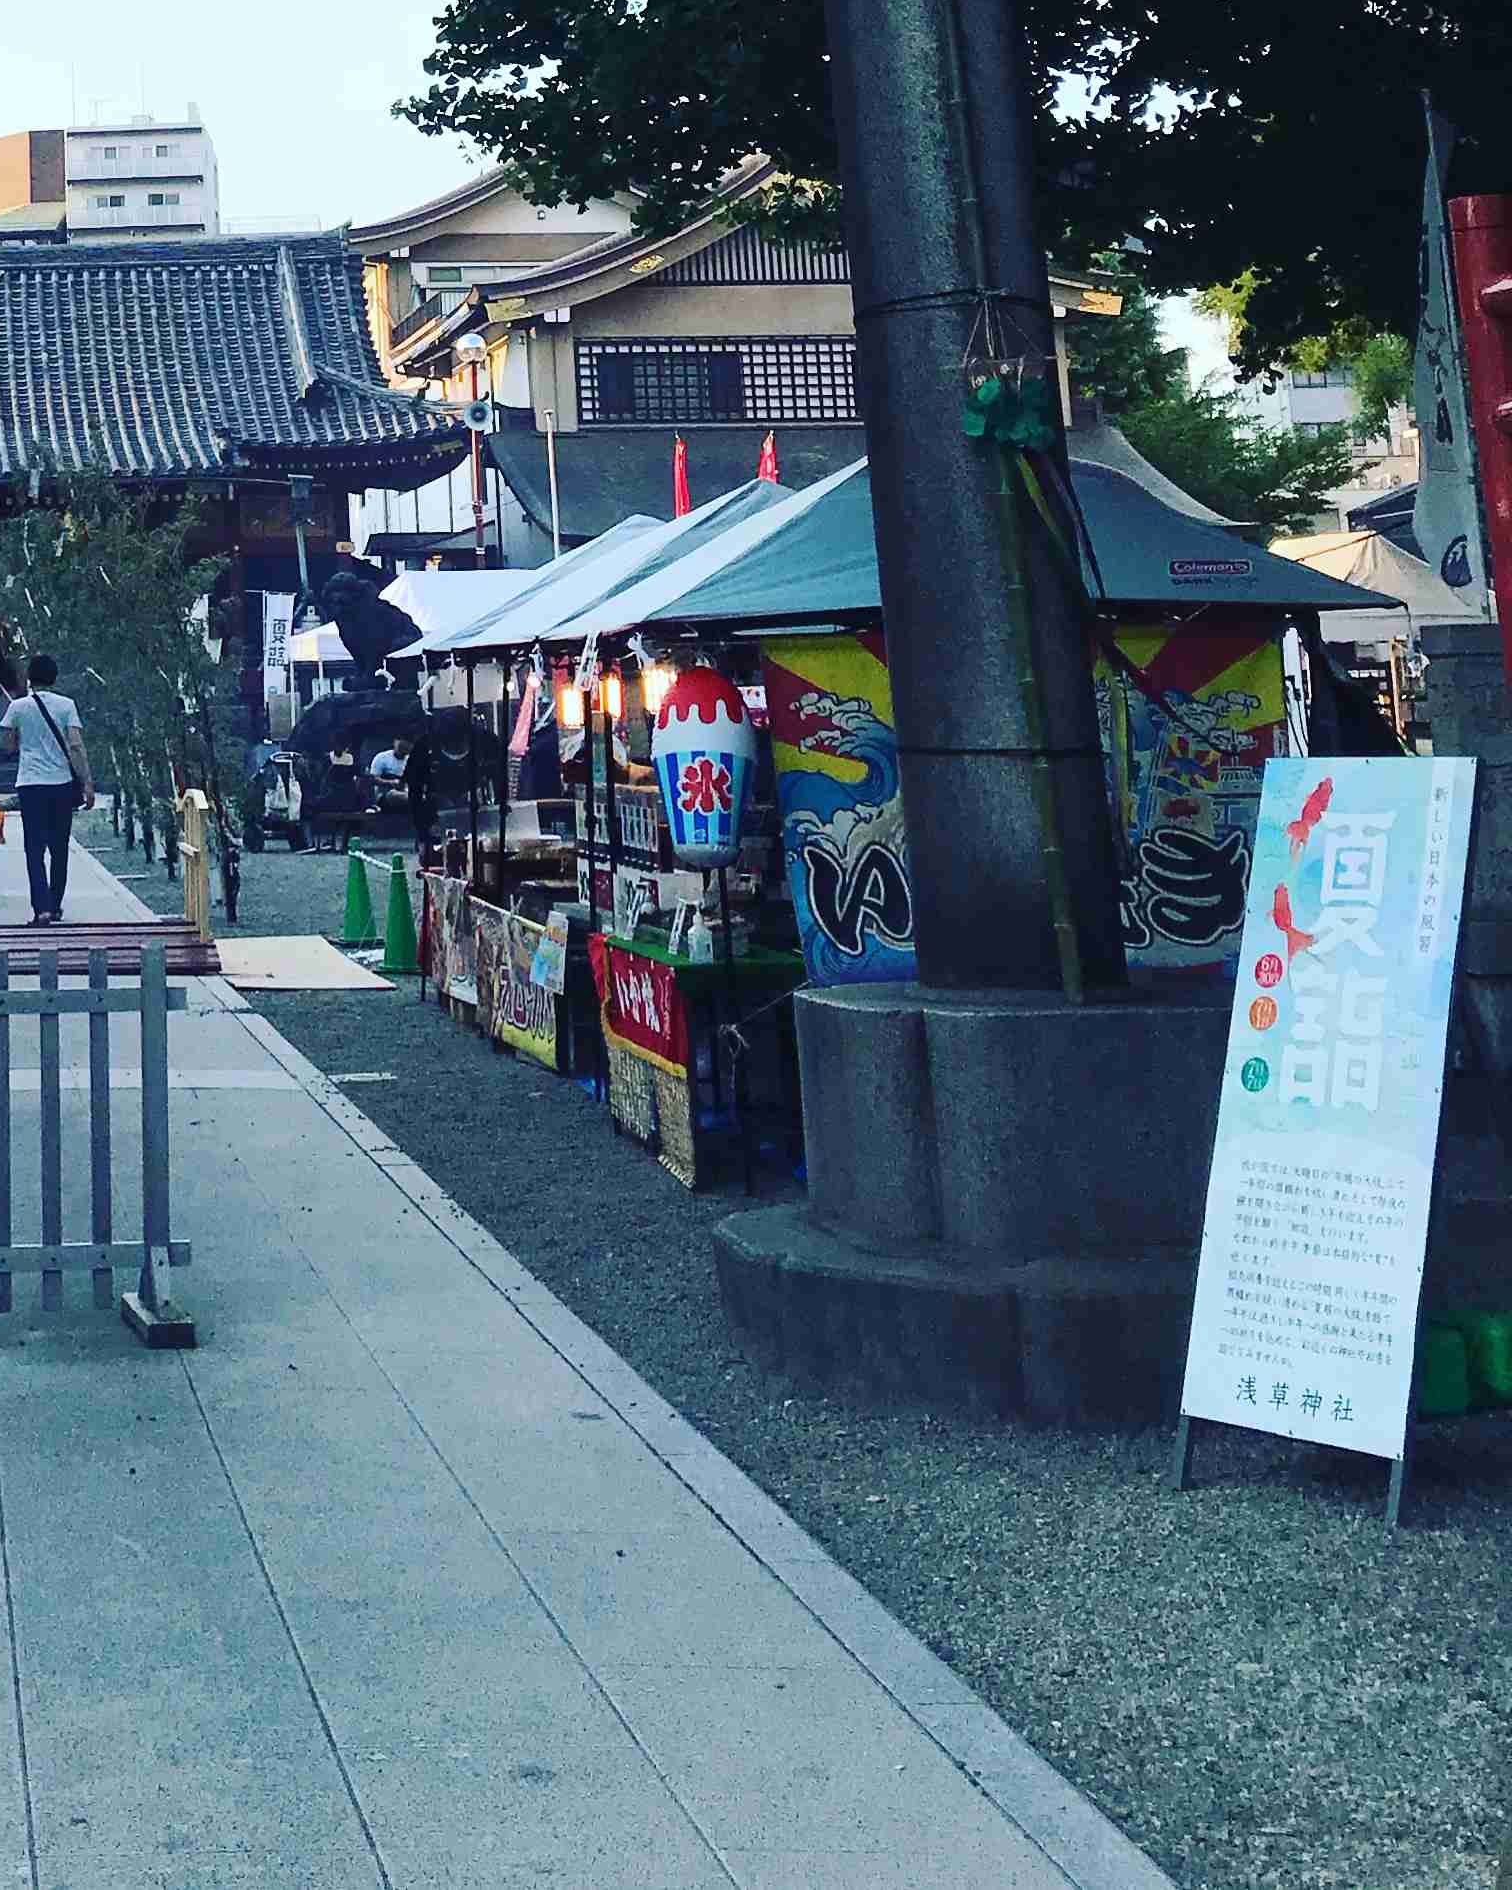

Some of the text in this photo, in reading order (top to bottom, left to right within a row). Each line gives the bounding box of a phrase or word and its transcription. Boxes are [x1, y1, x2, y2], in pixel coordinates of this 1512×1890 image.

[1174, 561, 1234, 574] Coleman
[681, 758, 733, 814] 氷
[1418, 786, 1448, 954] 新しい日本の風習
[1277, 810, 1398, 1111] 夏詣
[1236, 1374, 1356, 1422] 浅草神社
